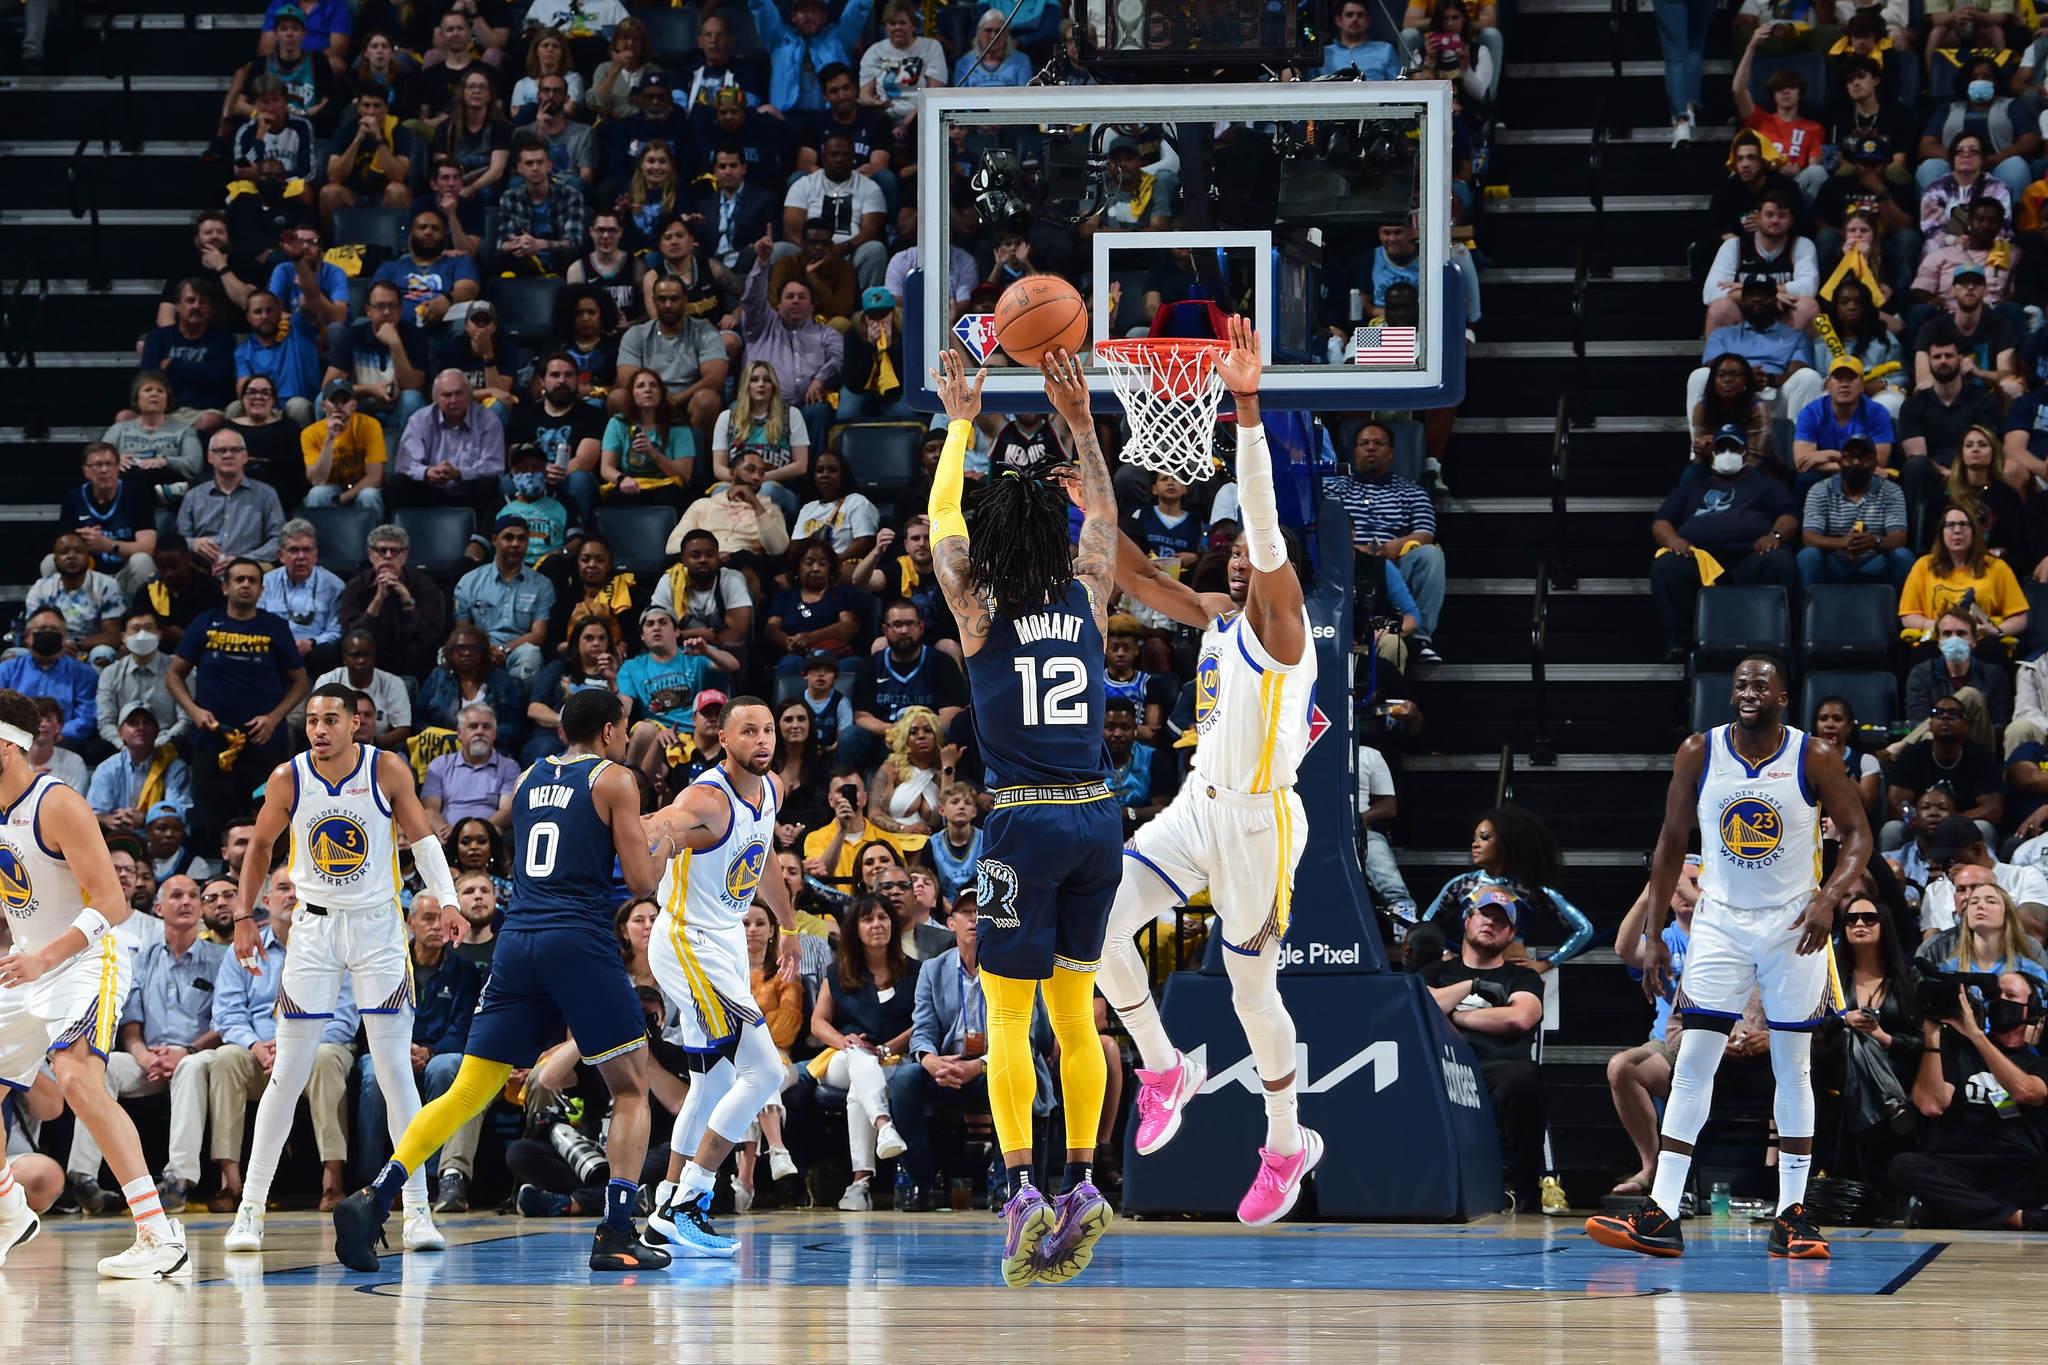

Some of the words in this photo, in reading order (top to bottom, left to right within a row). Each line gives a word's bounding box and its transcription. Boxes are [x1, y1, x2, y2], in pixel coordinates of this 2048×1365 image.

[1013, 612, 1084, 645] MORANT
[1014, 656, 1088, 725] 12
[529, 784, 575, 810] MELTON
[1719, 790, 1754, 810] GOLDEN
[1758, 791, 1784, 811] STATE
[306, 808, 340, 829] GOLDEN
[343, 809, 368, 828] STATE
[1752, 812, 1775, 830] 23
[345, 829, 358, 848] 3
[525, 822, 560, 877] 0
[732, 833, 758, 857] GOLDEN
[1720, 845, 1785, 870] WARRIORS
[14, 863, 22, 881] 11
[312, 861, 371, 887] WARRIORS
[1309, 942, 1360, 965] Pixel
